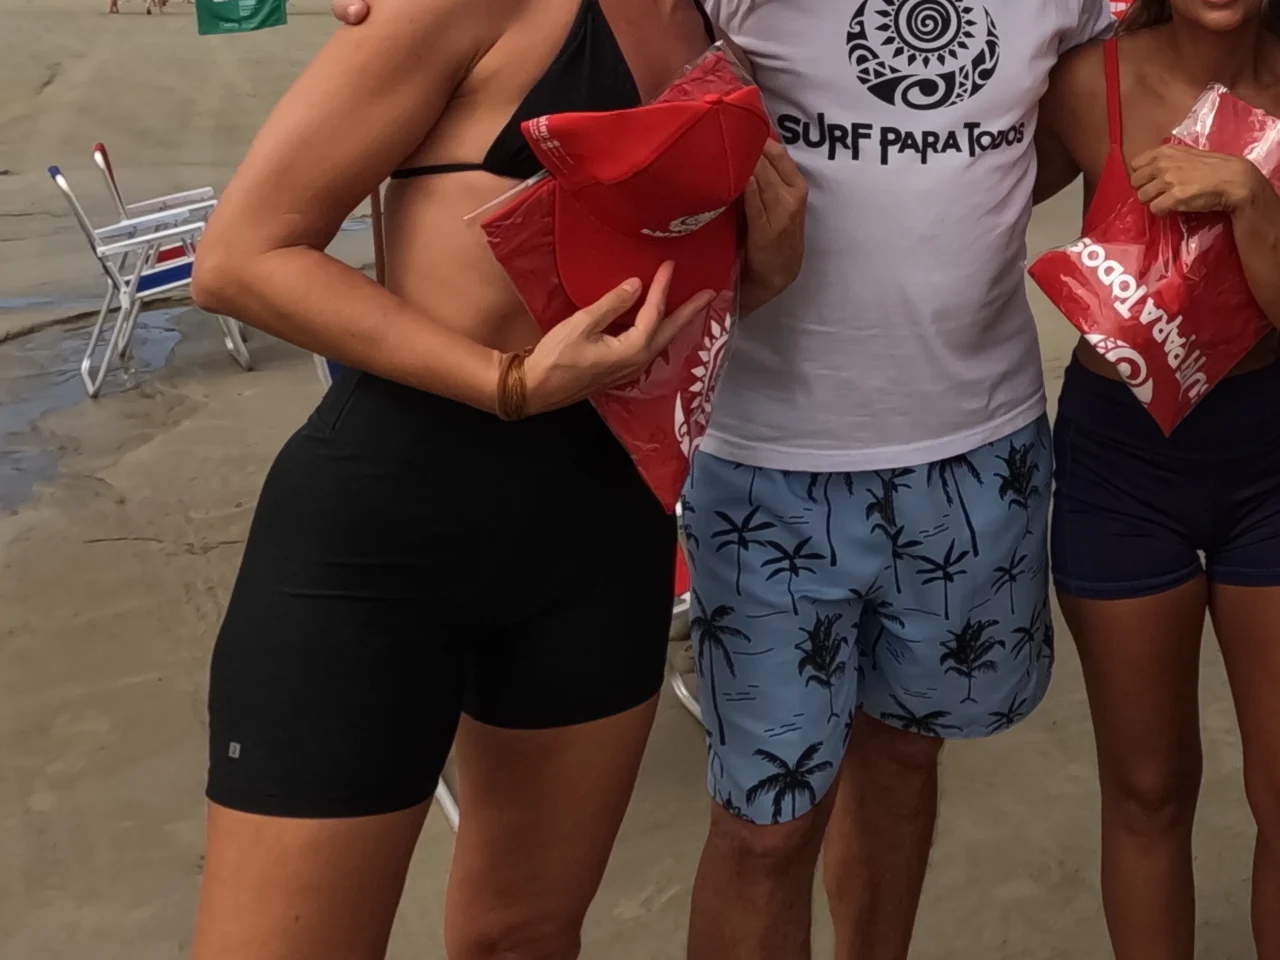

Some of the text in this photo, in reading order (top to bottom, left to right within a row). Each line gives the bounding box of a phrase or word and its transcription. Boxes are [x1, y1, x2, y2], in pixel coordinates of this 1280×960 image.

[777, 112, 1025, 165] SURF PARA TODOS
[1069, 237, 1148, 320] TODOS
[1139, 296, 1197, 370] PARA
